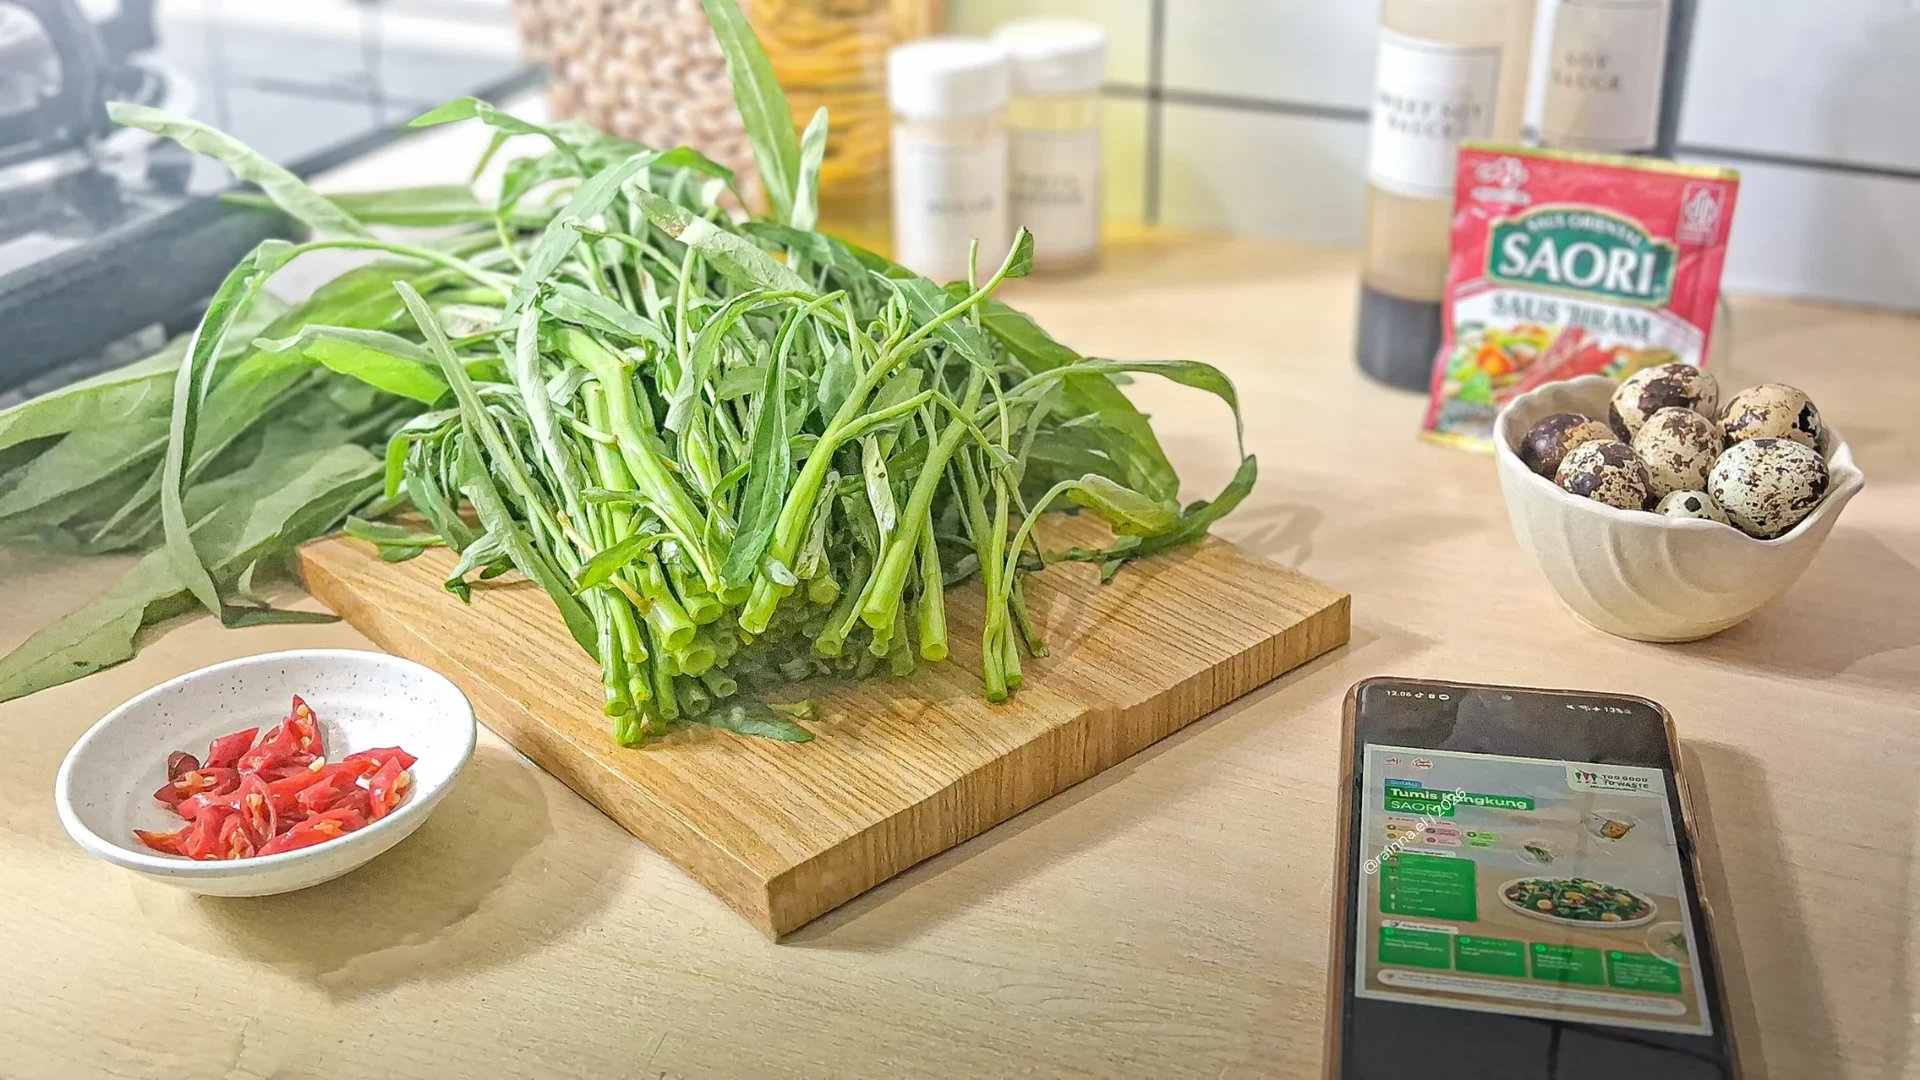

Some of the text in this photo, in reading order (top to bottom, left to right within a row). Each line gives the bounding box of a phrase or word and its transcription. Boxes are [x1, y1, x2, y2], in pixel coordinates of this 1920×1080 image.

[1498, 231, 1657, 296] SAORI
[1492, 295, 1651, 339] SAUS TIRAM
[1390, 788, 1438, 800] Tumis
